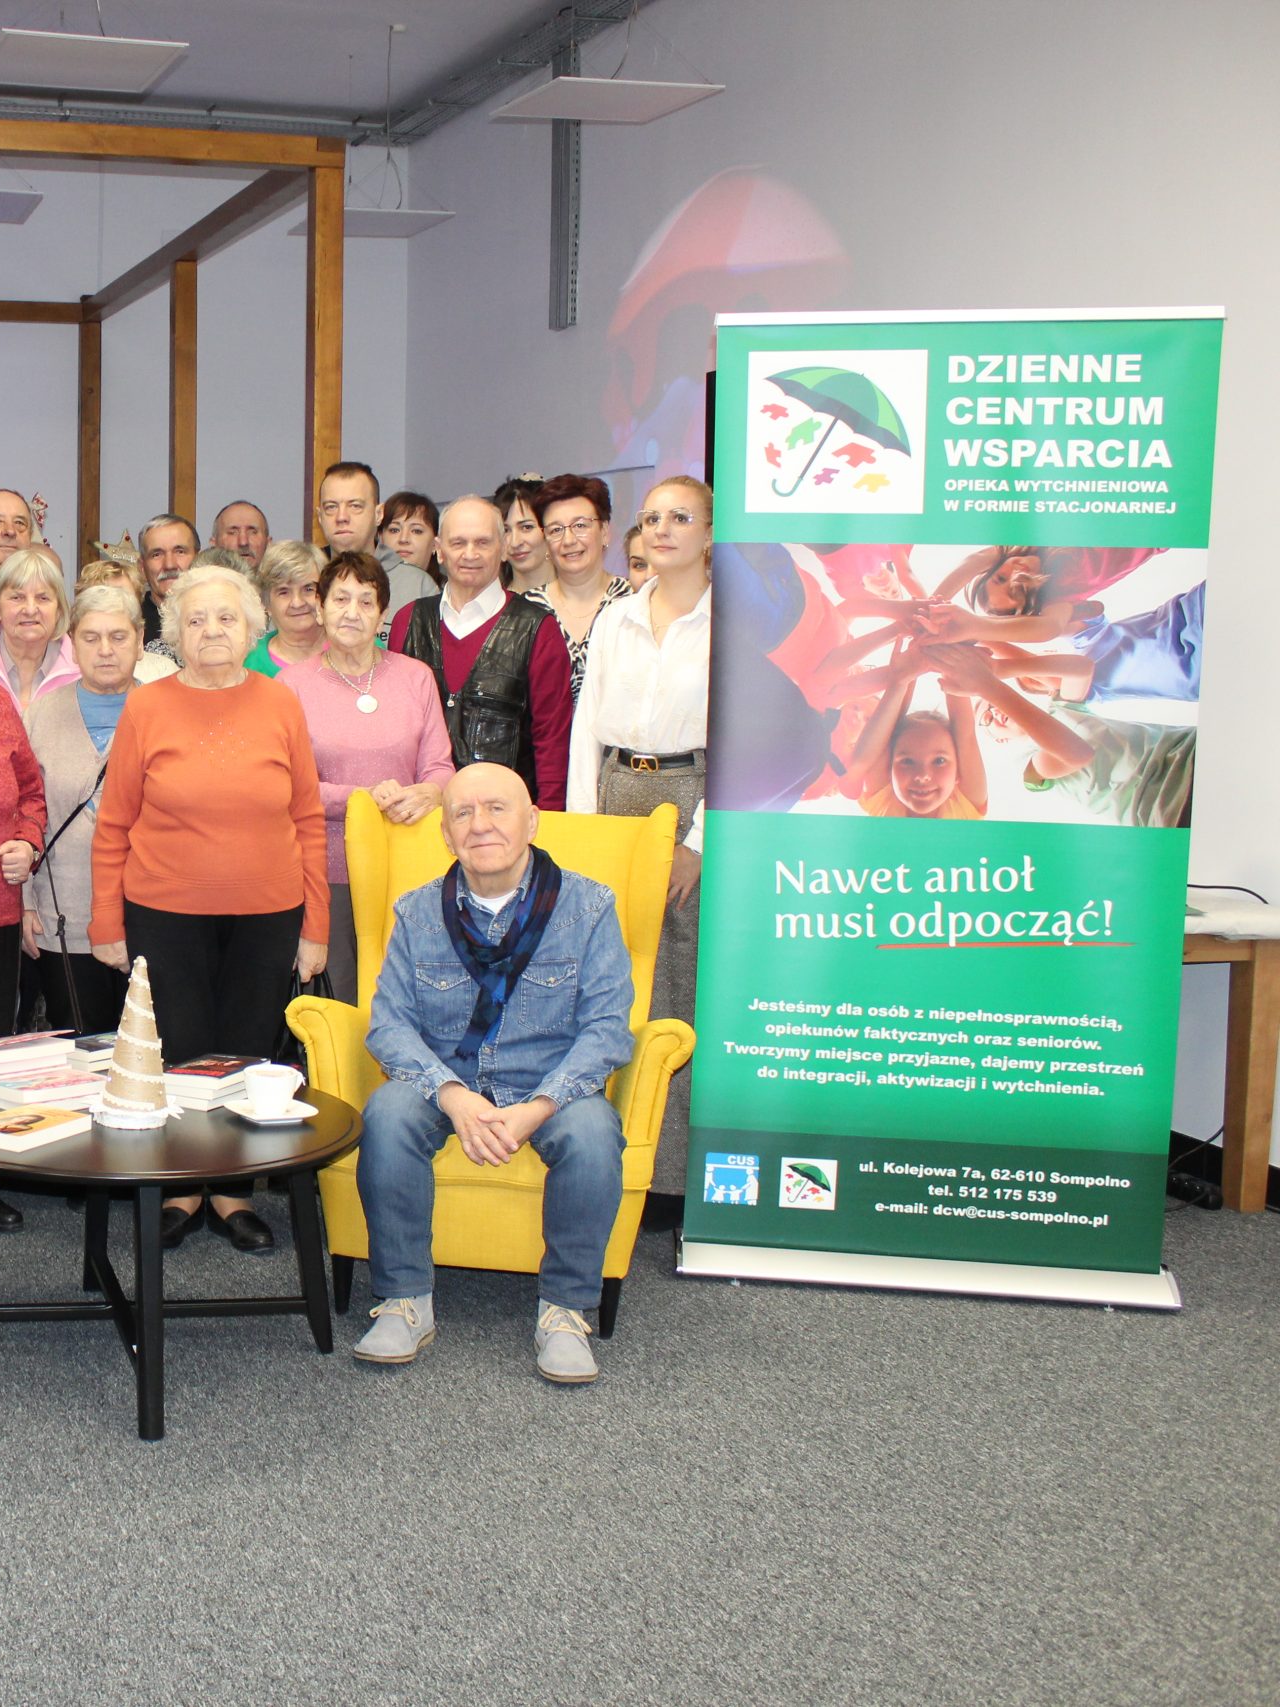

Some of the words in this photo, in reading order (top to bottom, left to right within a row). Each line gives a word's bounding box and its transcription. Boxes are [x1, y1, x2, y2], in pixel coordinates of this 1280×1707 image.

[949, 354, 1141, 383] DZIENNE
[946, 397, 1163, 425] CENTRUM
[944, 439, 1172, 468] WSPARCIA
[945, 479, 1009, 491] OPIEKA
[1015, 480, 1168, 492] WYTCHNIENIOWA
[944, 500, 959, 511] W
[965, 500, 1029, 512] FORMIE
[1035, 501, 1176, 513] STACJONARNEJ
[776, 860, 912, 894] Nawet
[925, 856, 1035, 893] anioł
[776, 903, 876, 938] musi
[889, 900, 1114, 947] odpocząć!
[749, 998, 831, 1017] Jesteśmy
[836, 1003, 863, 1015] dla
[868, 1005, 910, 1018] osób
[915, 1010, 924, 1018] z
[929, 1008, 1123, 1031] niepełnosprawnością,
[765, 1023, 859, 1037] opiekunów
[864, 1026, 968, 1045] faktycznych
[974, 1035, 1012, 1046] oraz
[1018, 1036, 1102, 1050] seniorów.
[724, 1042, 810, 1060] Tworzymy
[816, 1048, 883, 1063] miejsce
[888, 1052, 975, 1069] przyjazne,
[981, 1056, 1045, 1072] dajemy
[1050, 1062, 1144, 1076] przestrzeń
[757, 1066, 778, 1078] do
[784, 1067, 871, 1085] integracji,
[877, 1073, 976, 1091] aktywizacji
[982, 1078, 986, 1089] i
[992, 1080, 1104, 1095] wytchnienia.
[727, 1155, 755, 1166] CUS
[860, 1162, 878, 1172] ul.
[884, 1163, 956, 1177] Kolejowa
[962, 1167, 985, 1181] 7a,
[991, 1169, 1045, 1182] 62-610
[1050, 1172, 1130, 1187] Sompolno
[928, 1185, 953, 1196] tel.
[959, 1187, 988, 1198] 512
[994, 1189, 1022, 1200] 175
[1028, 1191, 1057, 1202] 539
[875, 1203, 928, 1214] e-mail:
[933, 1205, 1108, 1227] dcw@cus-sompolno.pl
